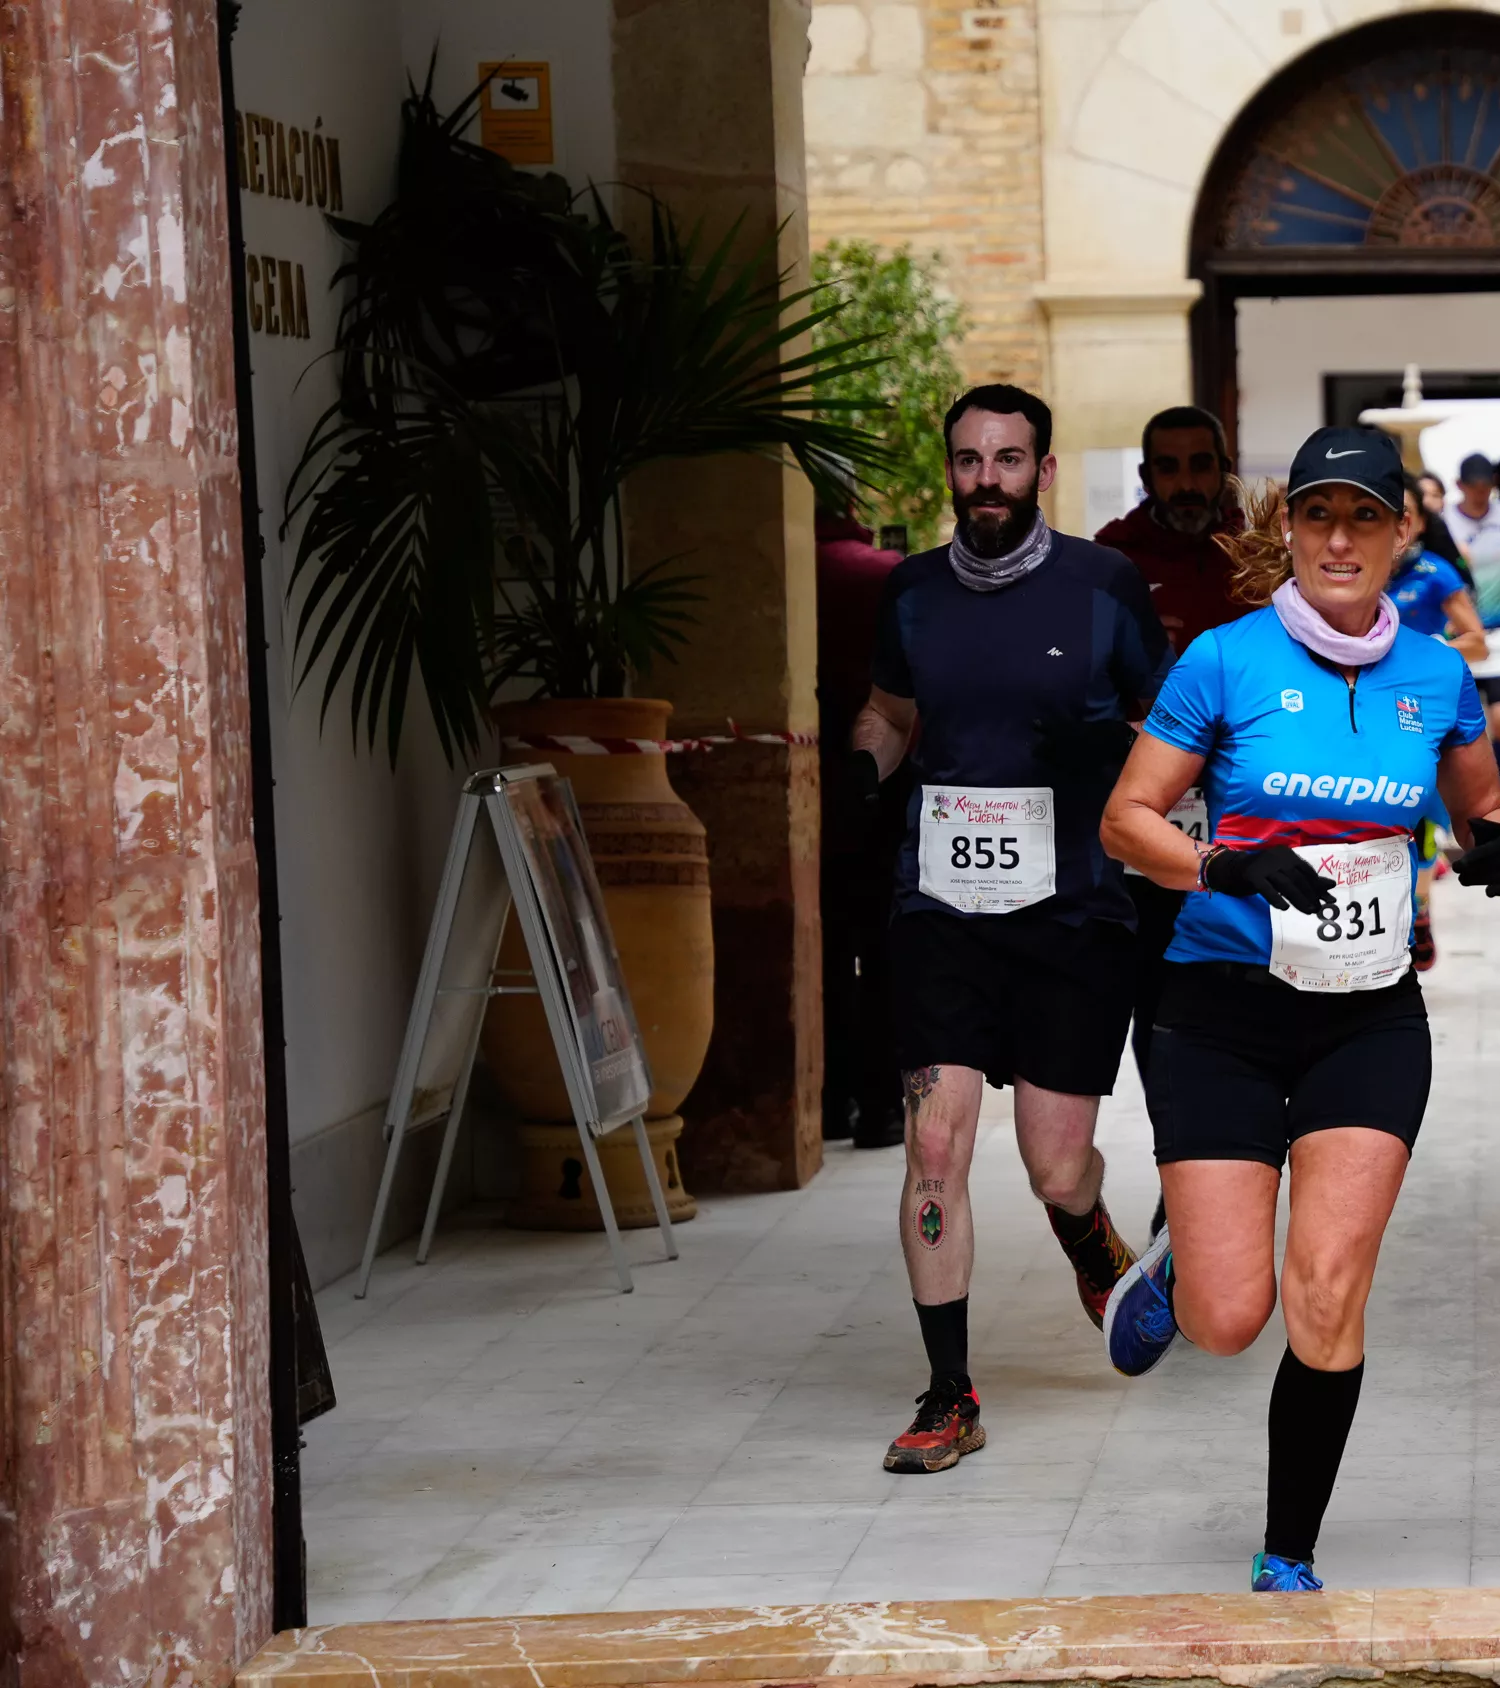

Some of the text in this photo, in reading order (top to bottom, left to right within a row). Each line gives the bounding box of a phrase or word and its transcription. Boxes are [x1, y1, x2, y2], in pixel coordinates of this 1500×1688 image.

[1398, 711, 1414, 720] Club
[1399, 716, 1424, 728] Maratón
[1400, 723, 1423, 734] Lucena
[1263, 771, 1424, 808] enerplus
[968, 810, 1011, 825] LUCENA
[1170, 820, 1203, 841] 4
[951, 836, 1020, 869] 855
[1337, 869, 1373, 886] LUCENA
[1317, 897, 1386, 942] 831
[915, 1178, 945, 1195] ARETÉ
